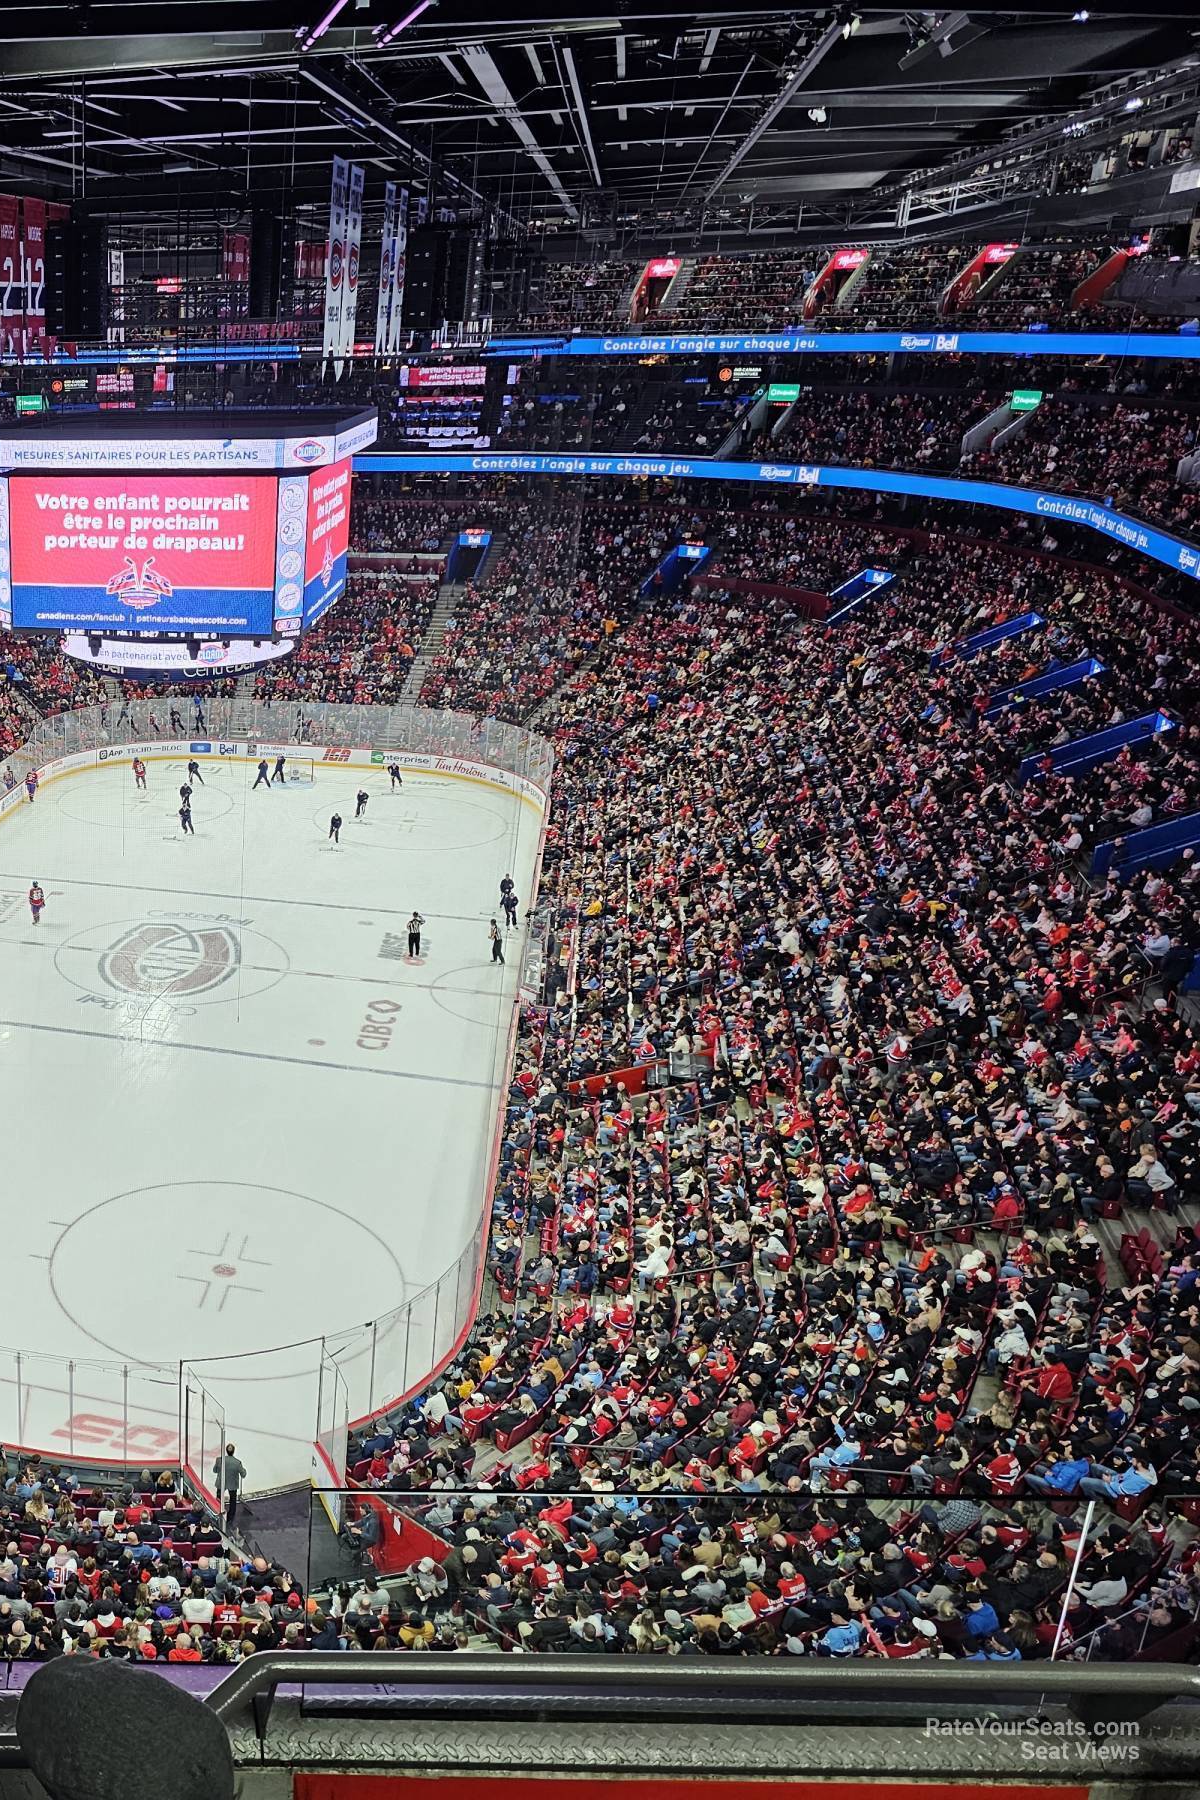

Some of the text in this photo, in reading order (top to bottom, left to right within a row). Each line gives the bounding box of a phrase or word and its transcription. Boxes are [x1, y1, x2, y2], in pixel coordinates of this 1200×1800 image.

[3, 256, 14, 317] 2
[25, 257, 46, 317] 12
[603, 337, 820, 352] Contrôlez l'angle sur chaque jeu.
[936, 334, 959, 351] Bell
[14, 450, 259, 461] MESURES SANITAIRES POUR LES PARTISANS
[472, 458, 694, 476] Contrôlez l'angle sur chaque jeu.
[799, 467, 820, 483] Bell
[35, 493, 250, 513] Votre enfant pourrait
[63, 512, 220, 534] être le prochain
[1036, 496, 1088, 519] Contrôlez
[1106, 518, 1118, 532] sur
[1115, 520, 1137, 542] chaque
[44, 532, 246, 552] porteur de drapeau!
[468, 535, 481, 545] Bell
[36, 612, 126, 623] canadiens.com/fanclub
[112, 651, 163, 661] partenariat
[164, 653, 188, 661] avec
[219, 743, 238, 755] Bell
[322, 748, 352, 763] IGA
[374, 752, 430, 766] enterprise
[434, 758, 488, 780] Tim Hortons
[356, 1013, 398, 1051] CIBC
